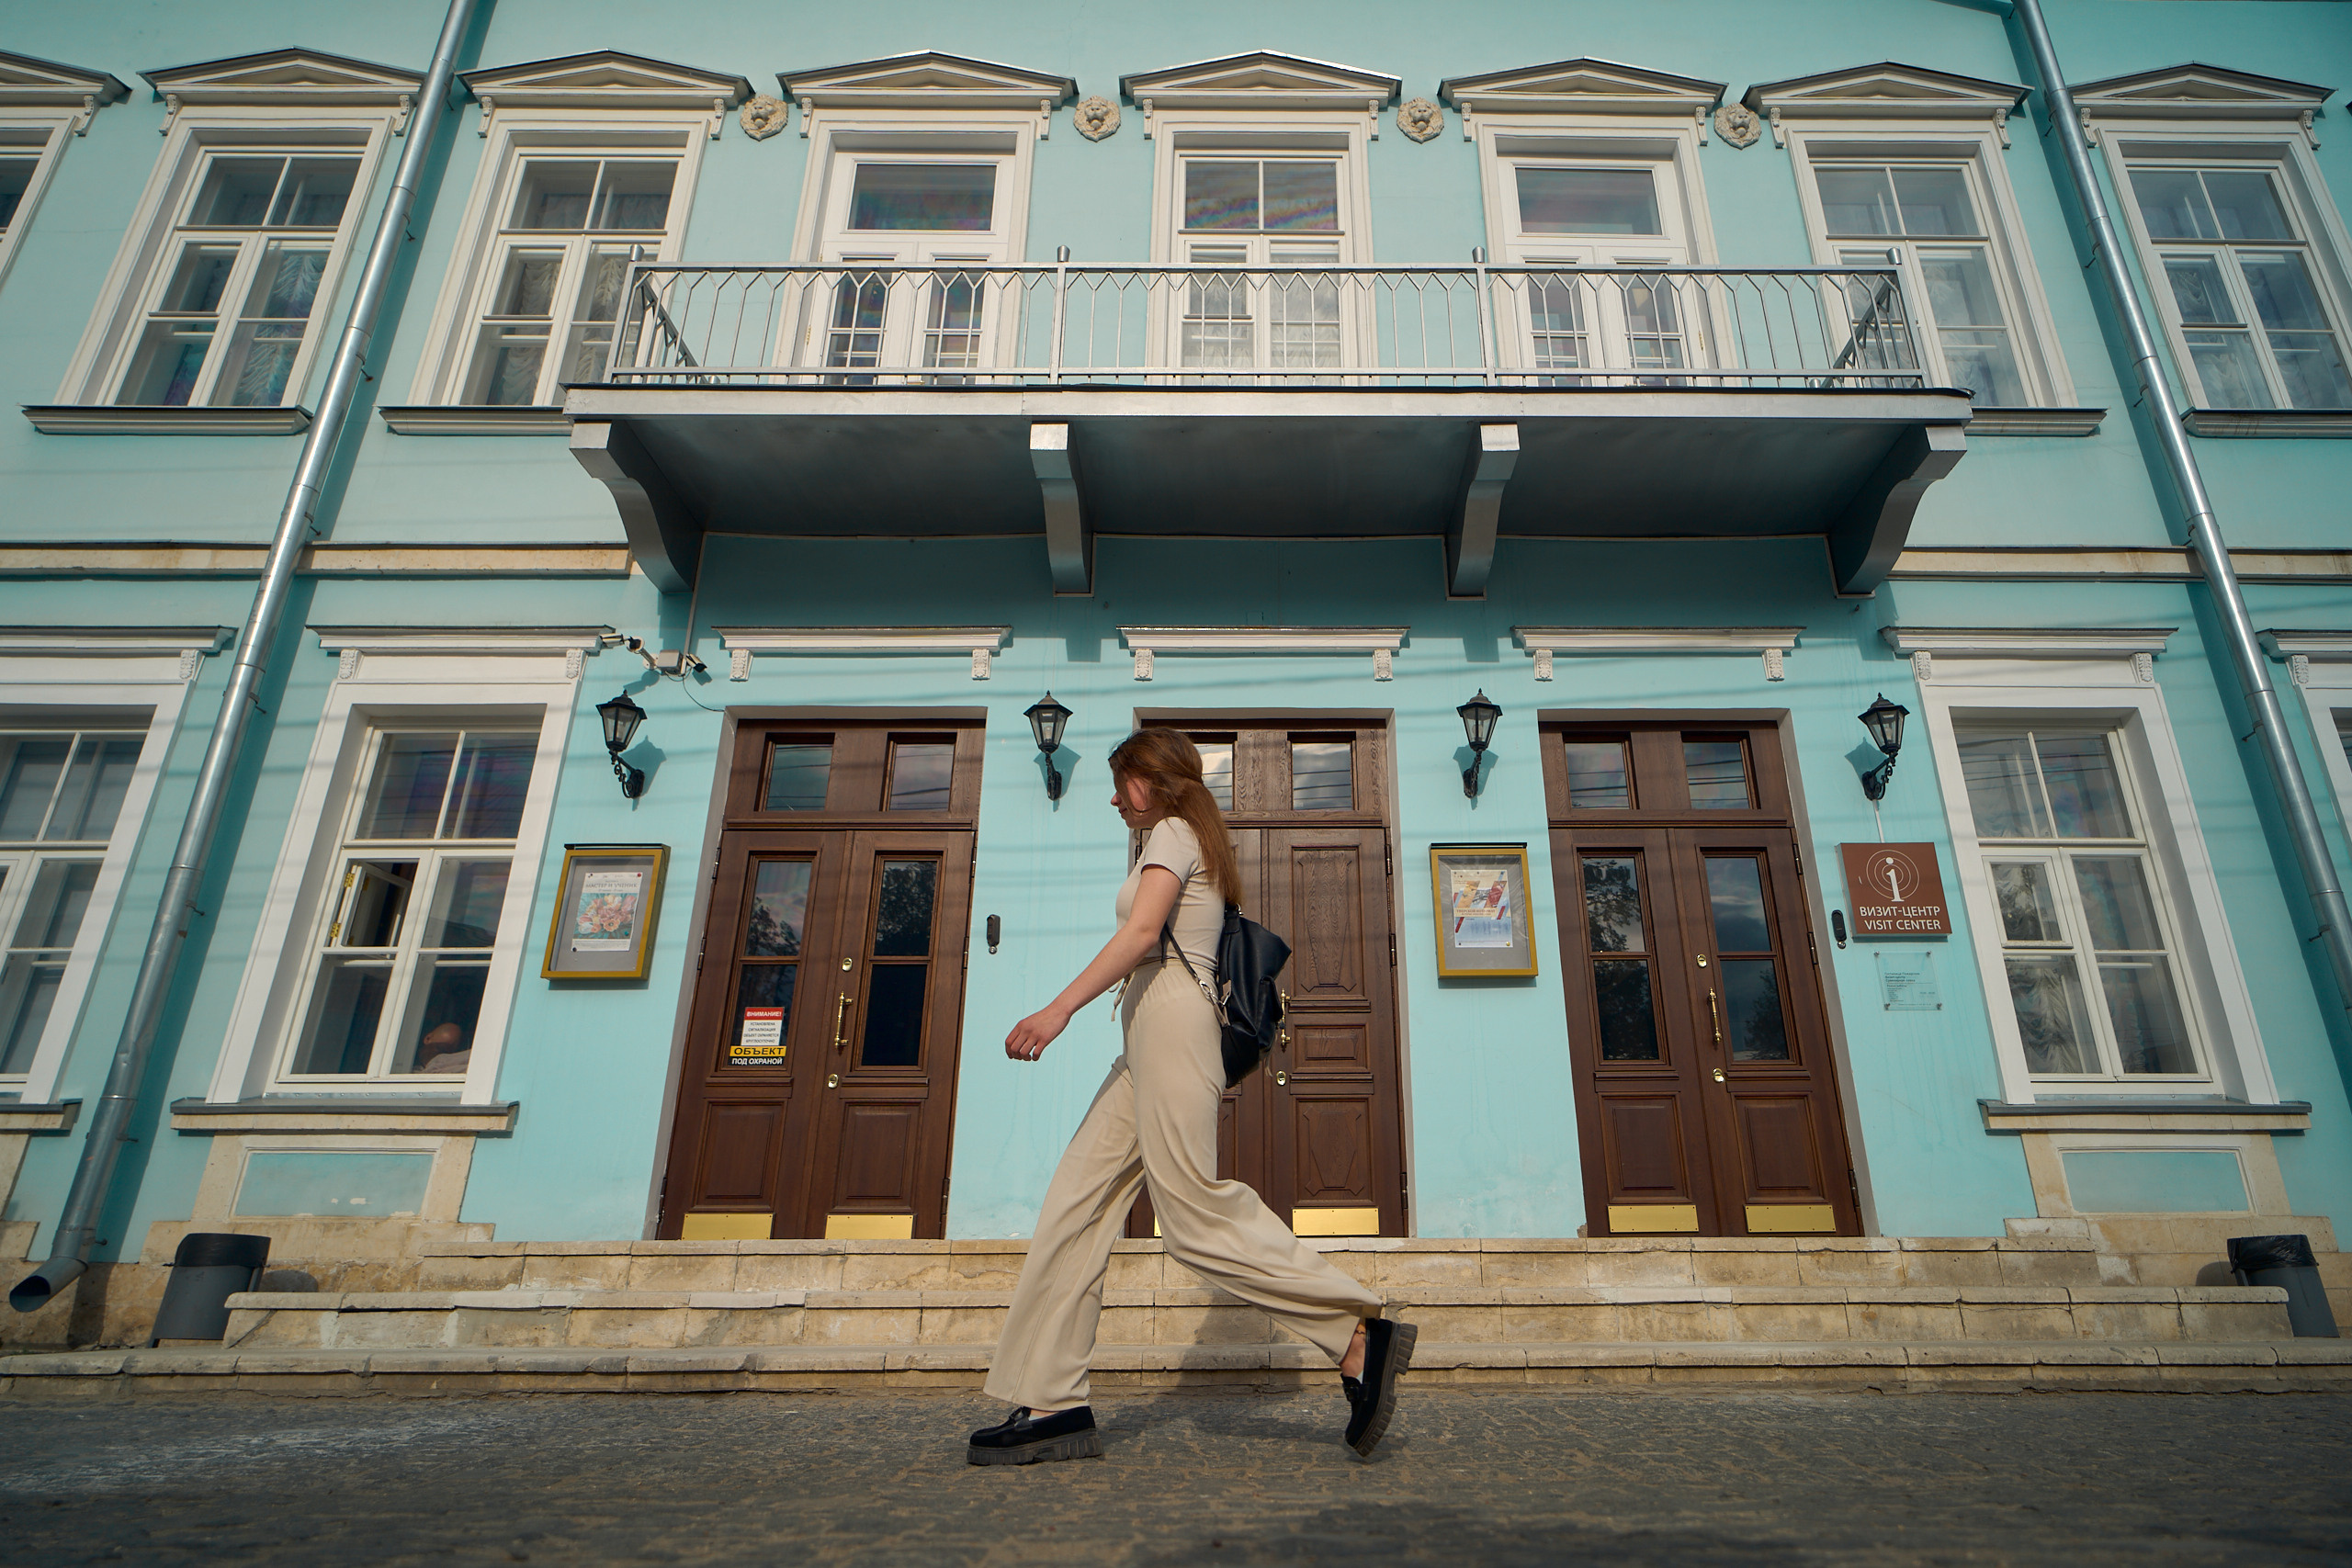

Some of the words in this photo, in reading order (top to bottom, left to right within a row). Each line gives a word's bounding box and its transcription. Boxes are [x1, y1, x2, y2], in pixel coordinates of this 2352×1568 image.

[1859, 906, 1940, 919] ВИЗИТ-ЦЕНТР
[1864, 919, 1893, 931] VISIT
[1895, 919, 1941, 931] CENTER
[733, 1047, 785, 1055] ОБЪЕКТ
[731, 1057, 748, 1066] ПОД
[749, 1056, 783, 1065] ОХРАНОЙ
